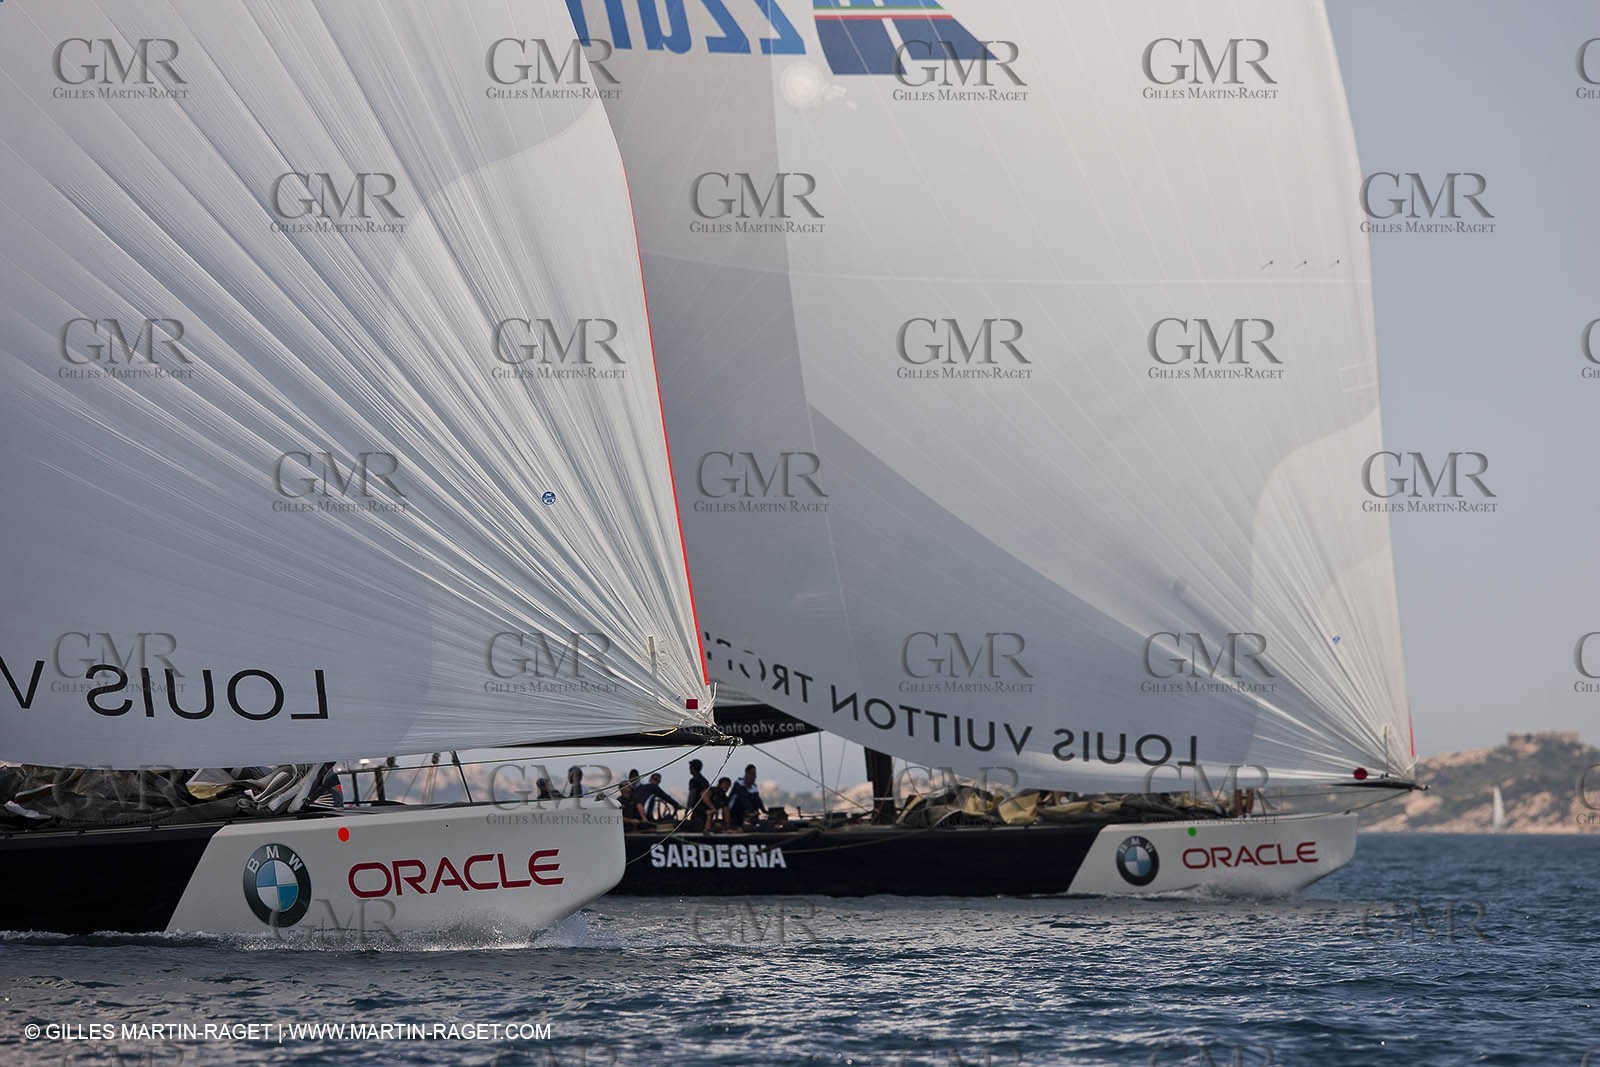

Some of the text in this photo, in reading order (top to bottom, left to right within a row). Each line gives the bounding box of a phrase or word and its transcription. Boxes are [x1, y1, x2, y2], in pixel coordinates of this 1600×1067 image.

[650, 843, 787, 868] SARDEGNA
[1182, 841, 1319, 869] ORACLE
[348, 849, 564, 898] ORACLE
